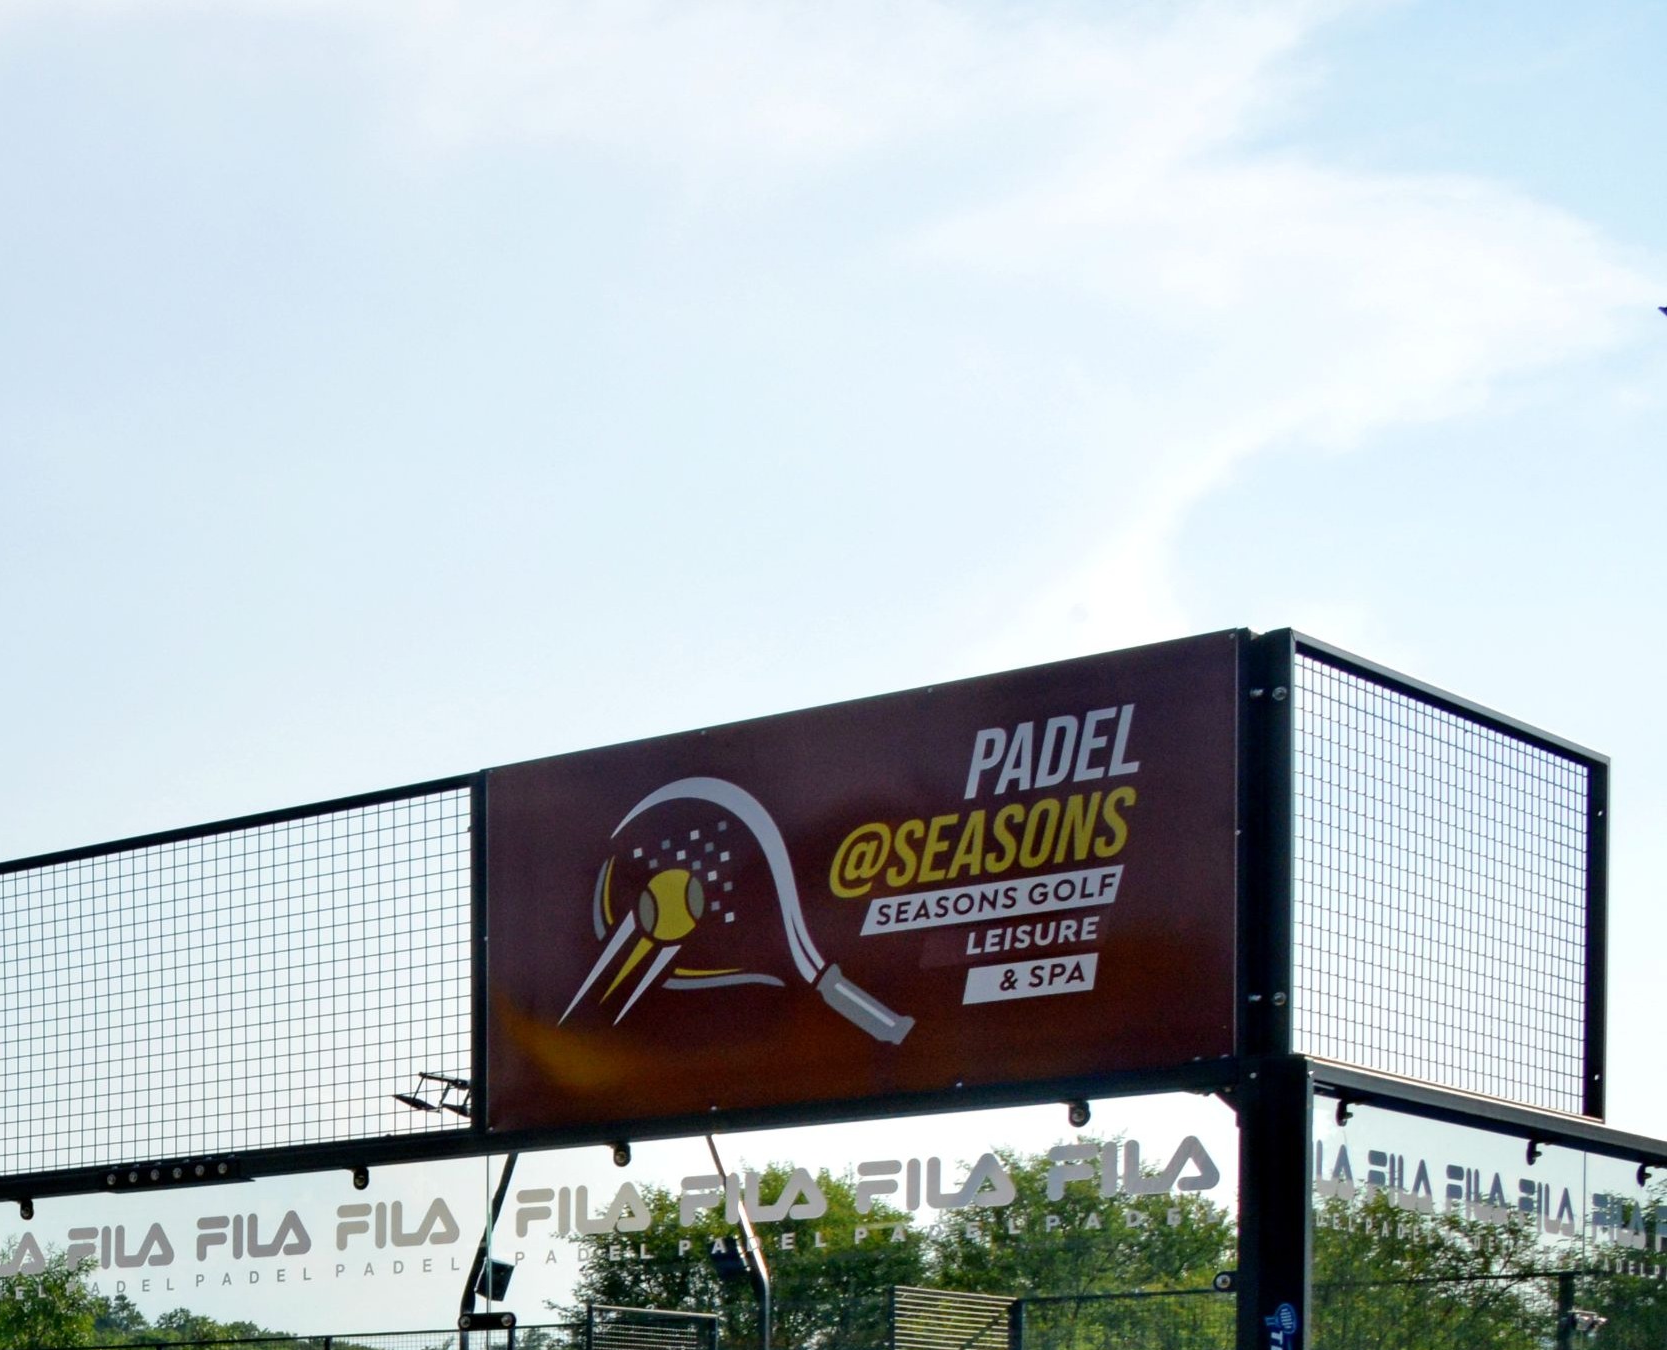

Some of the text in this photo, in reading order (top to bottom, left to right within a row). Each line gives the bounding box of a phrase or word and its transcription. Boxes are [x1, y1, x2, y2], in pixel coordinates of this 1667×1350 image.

[964, 703, 1140, 799] PADEL
[829, 785, 1137, 898] @SEASONS
[876, 873, 1116, 925] SEASONS GOLF
[966, 916, 1100, 955] LEISURE
[1000, 962, 1085, 991] & SPA
[67, 1222, 175, 1271] FILA
[196, 1210, 312, 1262] FILA
[336, 1197, 461, 1251] FILA
[516, 1181, 651, 1238] FILA
[680, 1167, 828, 1227] FILA
[856, 1152, 1016, 1215] FILA
[1047, 1135, 1220, 1201] FILA
[1316, 1139, 1355, 1201] LA
[1368, 1149, 1435, 1216] FILA
[1446, 1164, 1508, 1226] FILA
[1518, 1178, 1575, 1237] FILA
[1592, 1193, 1646, 1250] FILA
[195, 1266, 312, 1287] PADEL
[336, 1256, 460, 1278] PADEL
[515, 1243, 655, 1265] PADEL
